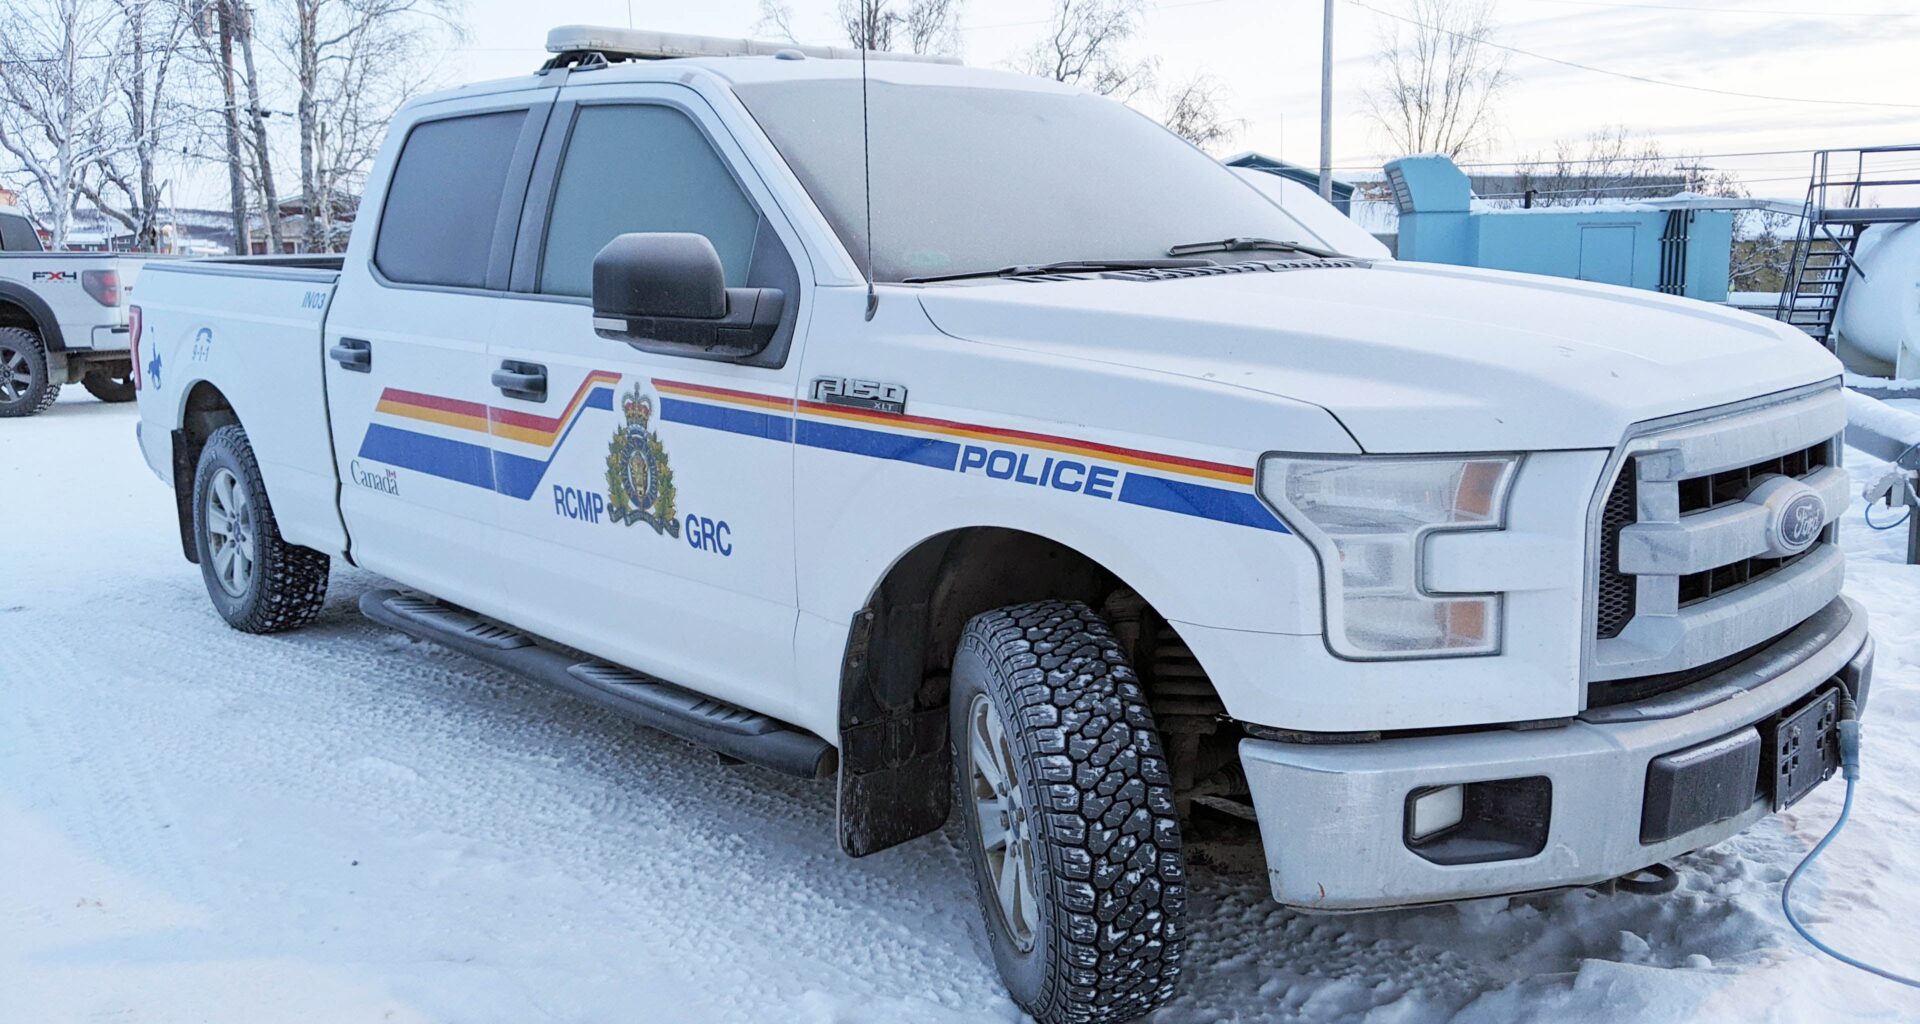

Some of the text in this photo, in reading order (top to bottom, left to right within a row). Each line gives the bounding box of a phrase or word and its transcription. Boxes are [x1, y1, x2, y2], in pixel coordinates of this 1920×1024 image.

[32, 271, 77, 281] FX4
[301, 291, 326, 309] IN03
[873, 401, 893, 410] XLT
[351, 459, 400, 497] Canada
[960, 445, 1119, 499] POLICE
[553, 484, 604, 524] RCMP
[685, 513, 732, 556] GRC
[1793, 503, 1820, 540] Ford
